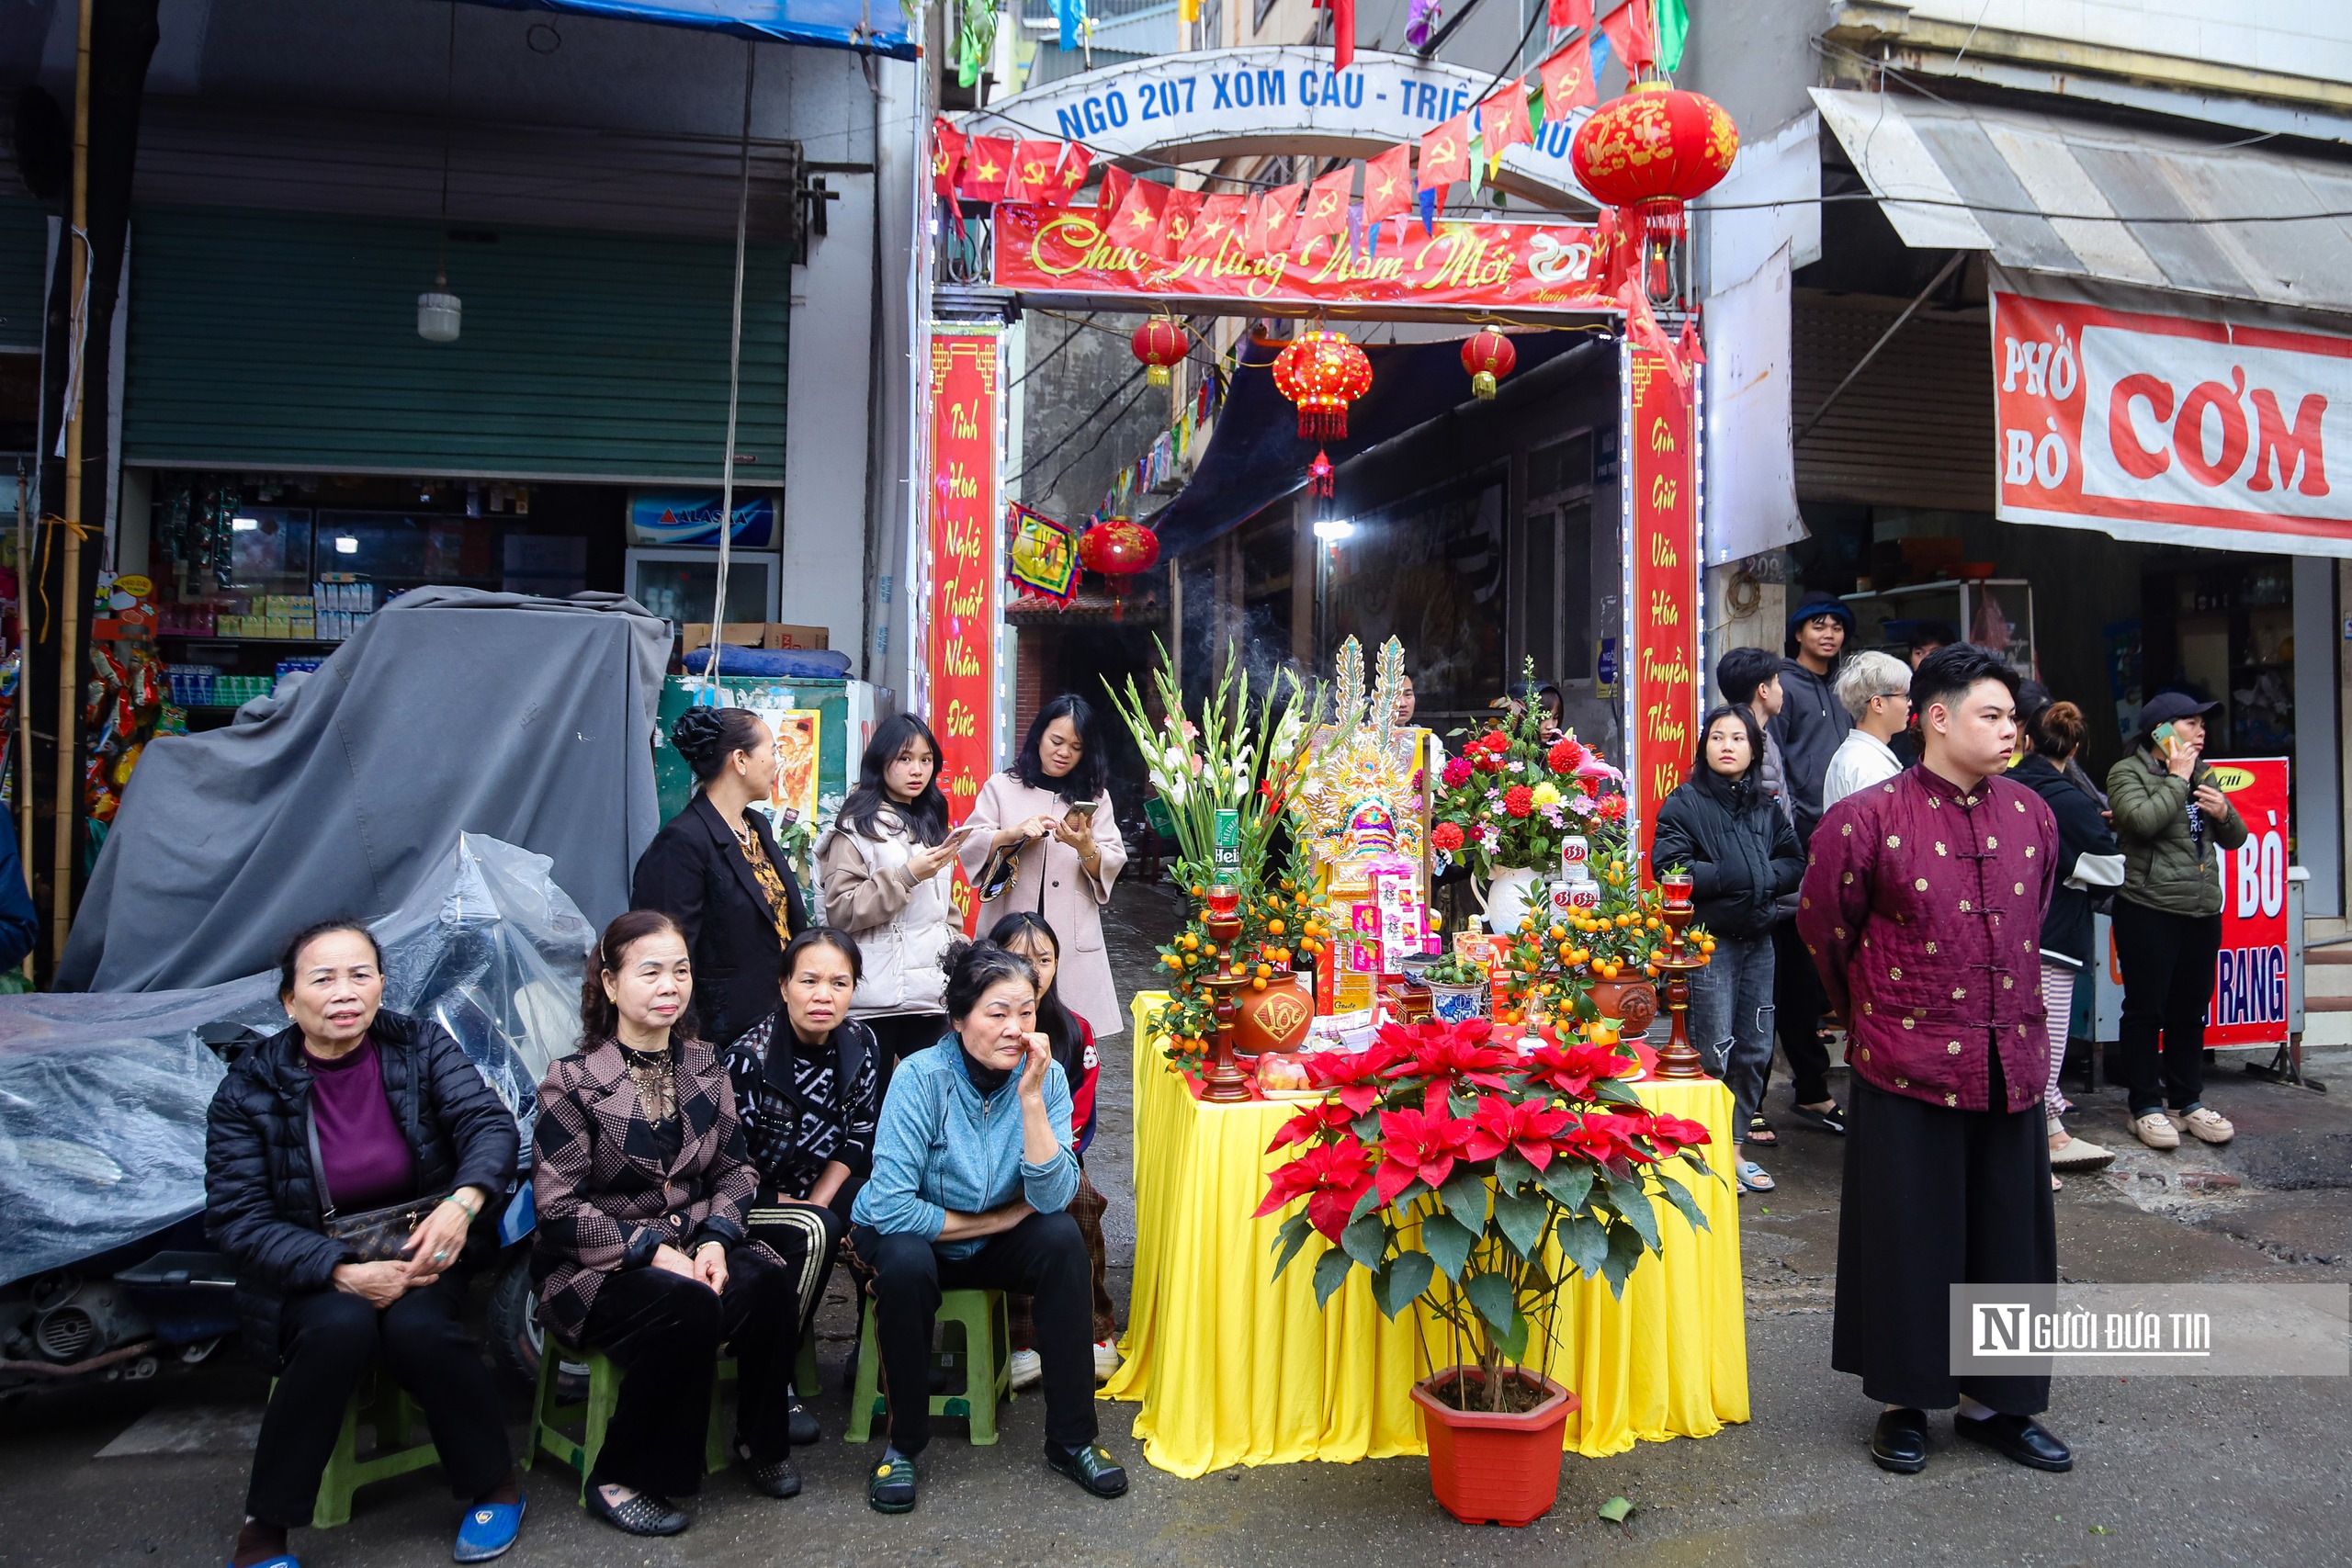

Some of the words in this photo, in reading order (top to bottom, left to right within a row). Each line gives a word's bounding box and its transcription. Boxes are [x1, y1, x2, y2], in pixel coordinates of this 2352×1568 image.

[1056, 81, 1128, 140] NGÕ
[1138, 77, 1196, 121] 207
[1211, 62, 1285, 109] XÓM
[1414, 229, 1516, 289] Mới
[2001, 323, 2078, 402] PHỞ
[950, 399, 978, 441] Tinh
[1651, 416, 1675, 458] Gìn
[2108, 364, 2331, 498] CƠM
[2004, 415, 2069, 491] BÒ
[948, 461, 978, 500] Hoa
[1651, 474, 1678, 515] Giữ
[944, 515, 981, 575] Nghệ
[1652, 532, 1678, 569] Văn
[943, 575, 984, 626] Thuật
[1651, 589, 1679, 627] Hóa
[943, 633, 980, 678] Nhân
[1643, 645, 1690, 701] Truyền
[946, 698, 976, 738] Đức
[1647, 701, 1685, 760] Thống
[951, 768, 978, 798] uôn
[1564, 844, 1585, 861] 333
[2237, 809, 2284, 919] BÒ
[2217, 944, 2286, 1026] RANG
